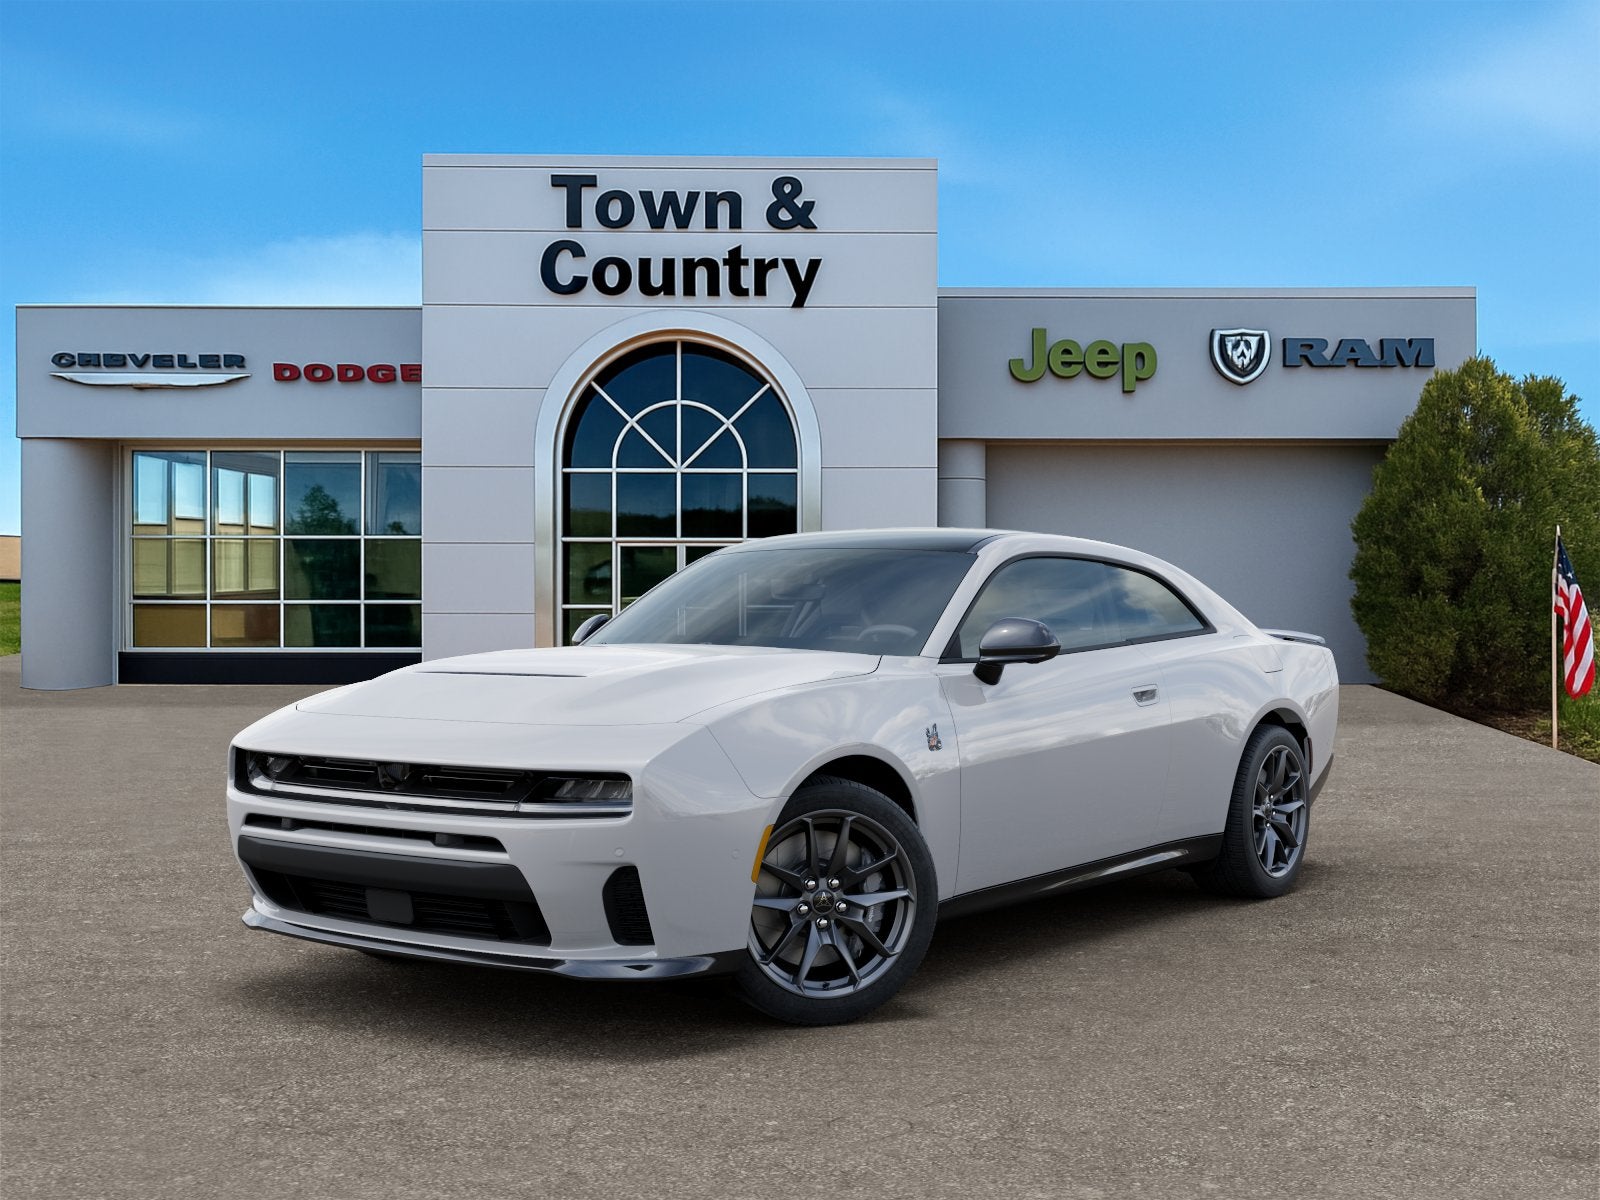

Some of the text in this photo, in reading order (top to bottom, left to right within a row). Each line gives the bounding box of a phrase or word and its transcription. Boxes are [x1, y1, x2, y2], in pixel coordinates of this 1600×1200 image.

[551, 174, 818, 229] Town &
[540, 240, 822, 308] Country
[273, 363, 422, 383] DODGE
[1008, 328, 1158, 392] Jeep
[1282, 338, 1435, 368] RAM
